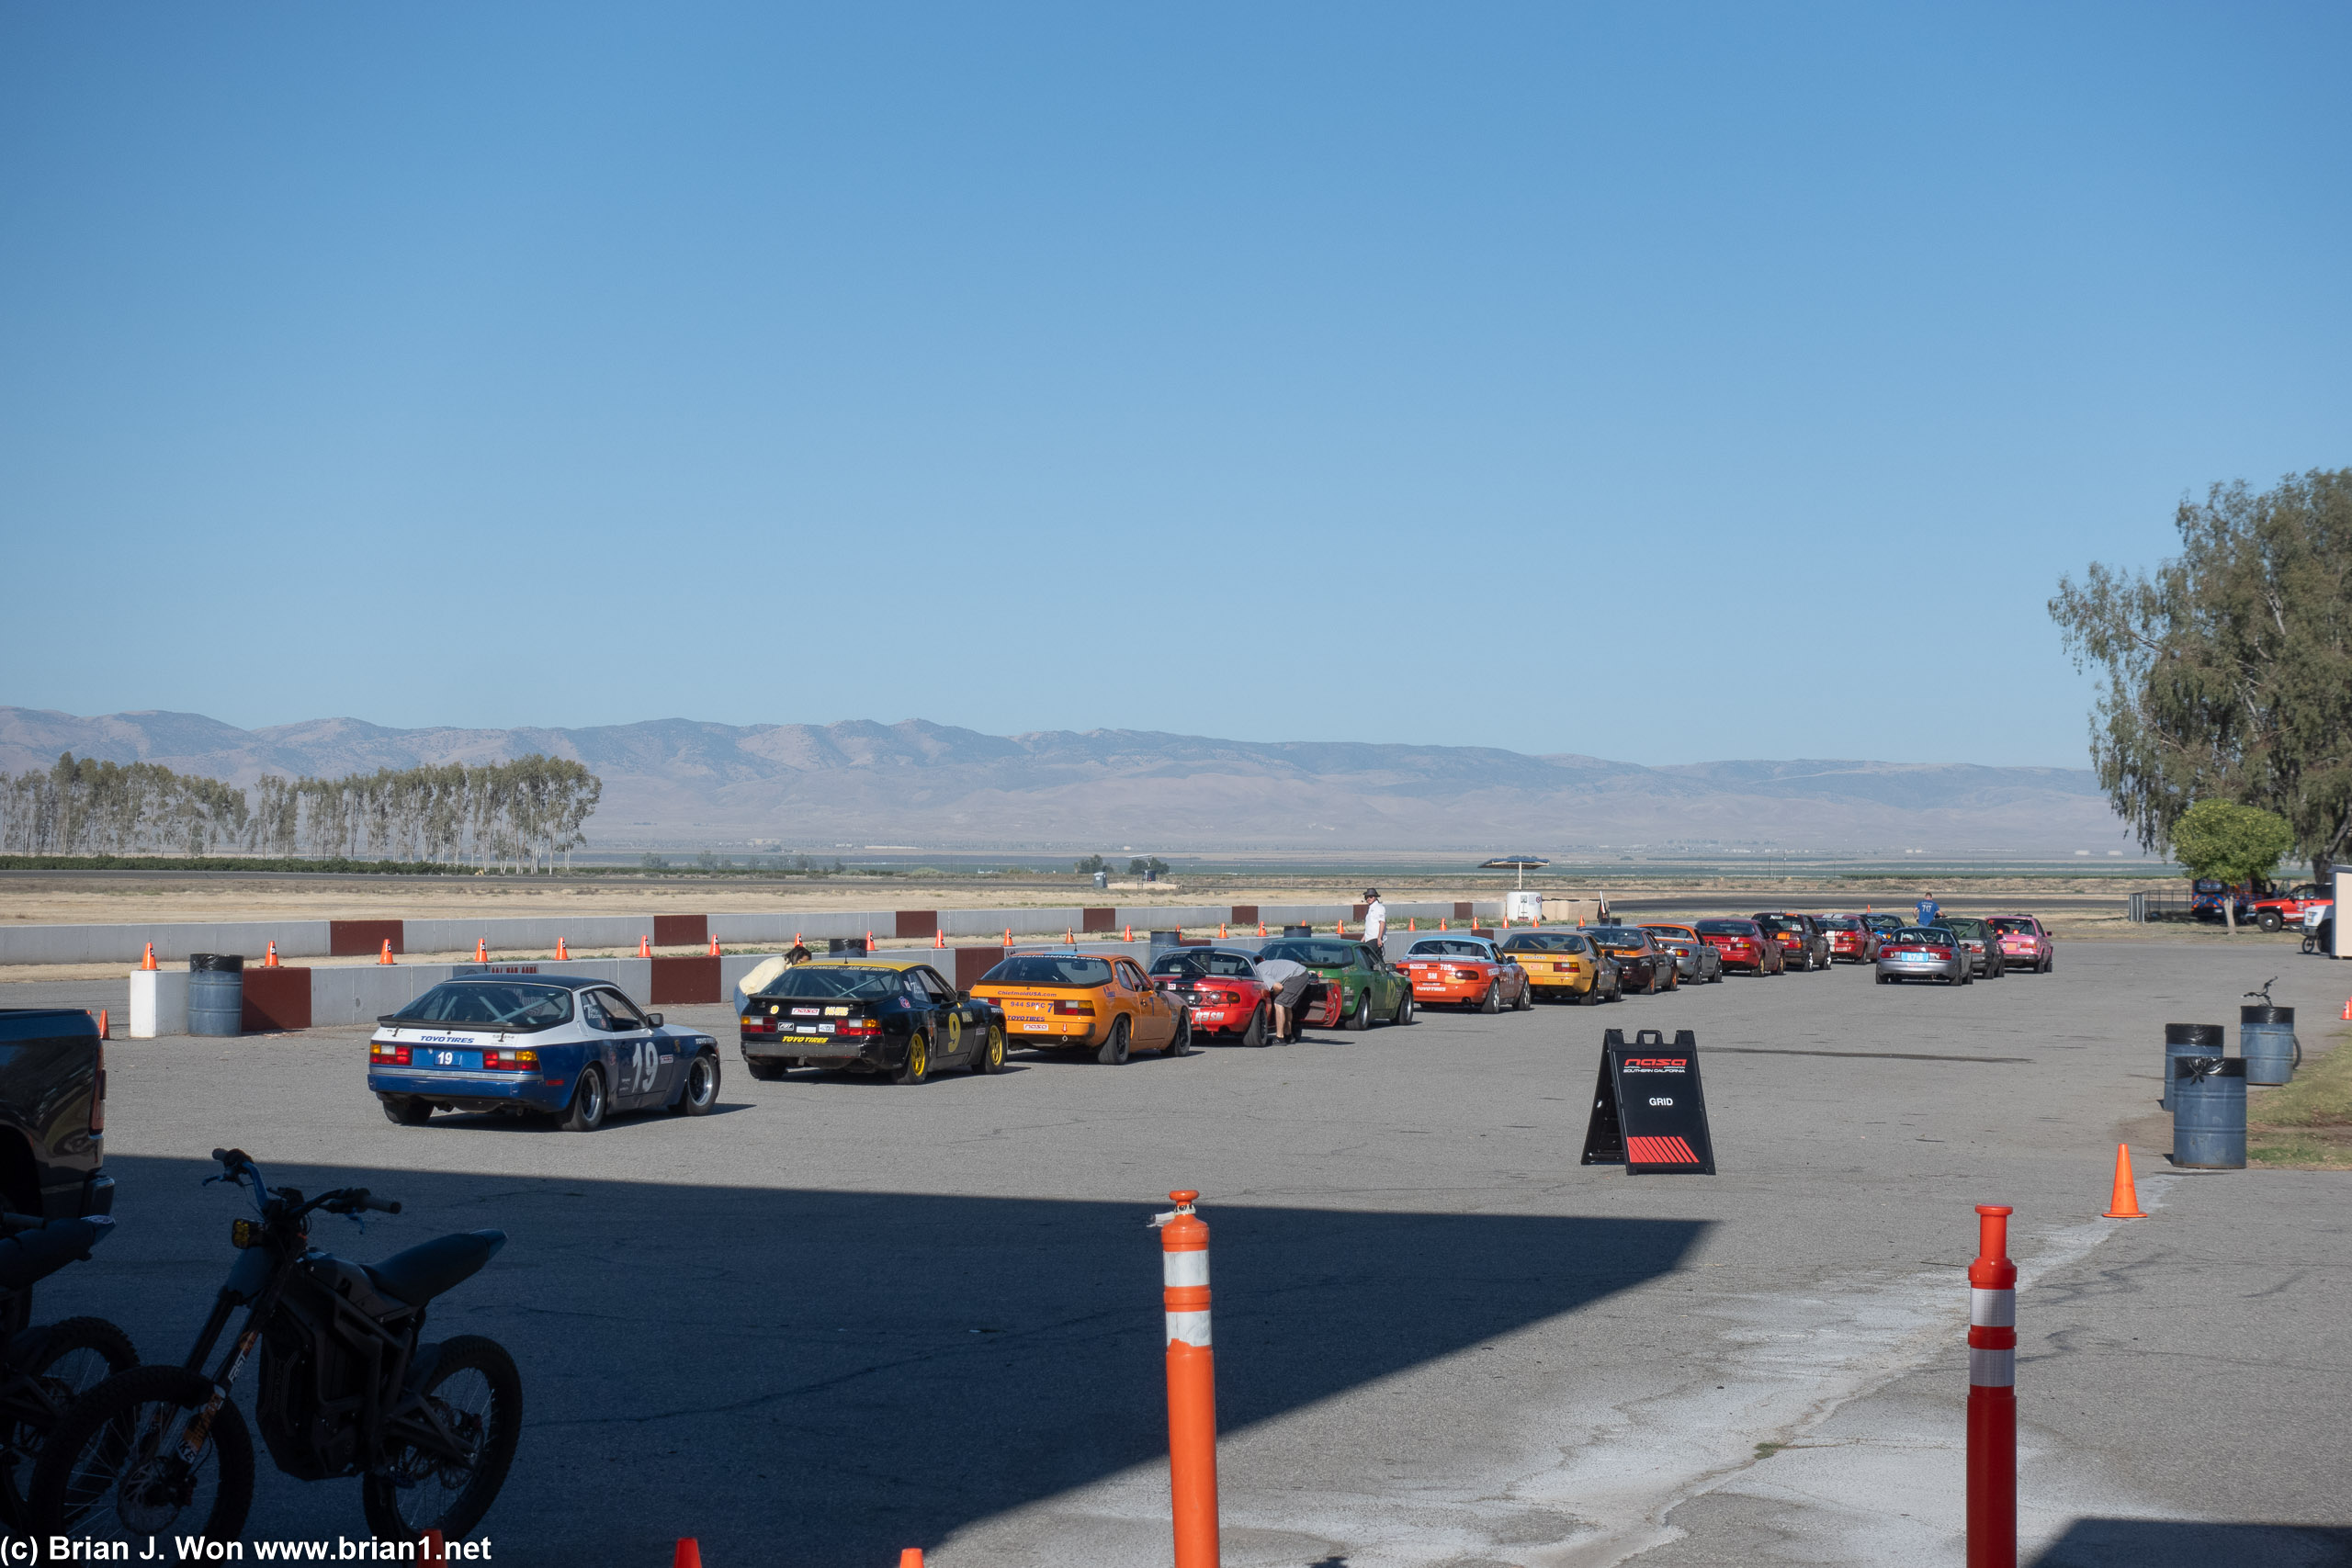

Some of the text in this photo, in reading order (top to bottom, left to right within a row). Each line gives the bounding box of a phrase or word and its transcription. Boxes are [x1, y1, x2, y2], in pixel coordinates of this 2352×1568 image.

[1427, 972, 1438, 980] SM
[770, 1005, 779, 1014] 9
[1047, 1002, 1054, 1013] 7
[1210, 1012, 1225, 1021] SM
[947, 1012, 961, 1053] 9
[437, 1051, 453, 1065] 19
[632, 1041, 659, 1093] 19
[1648, 1097, 1674, 1107] GRID
